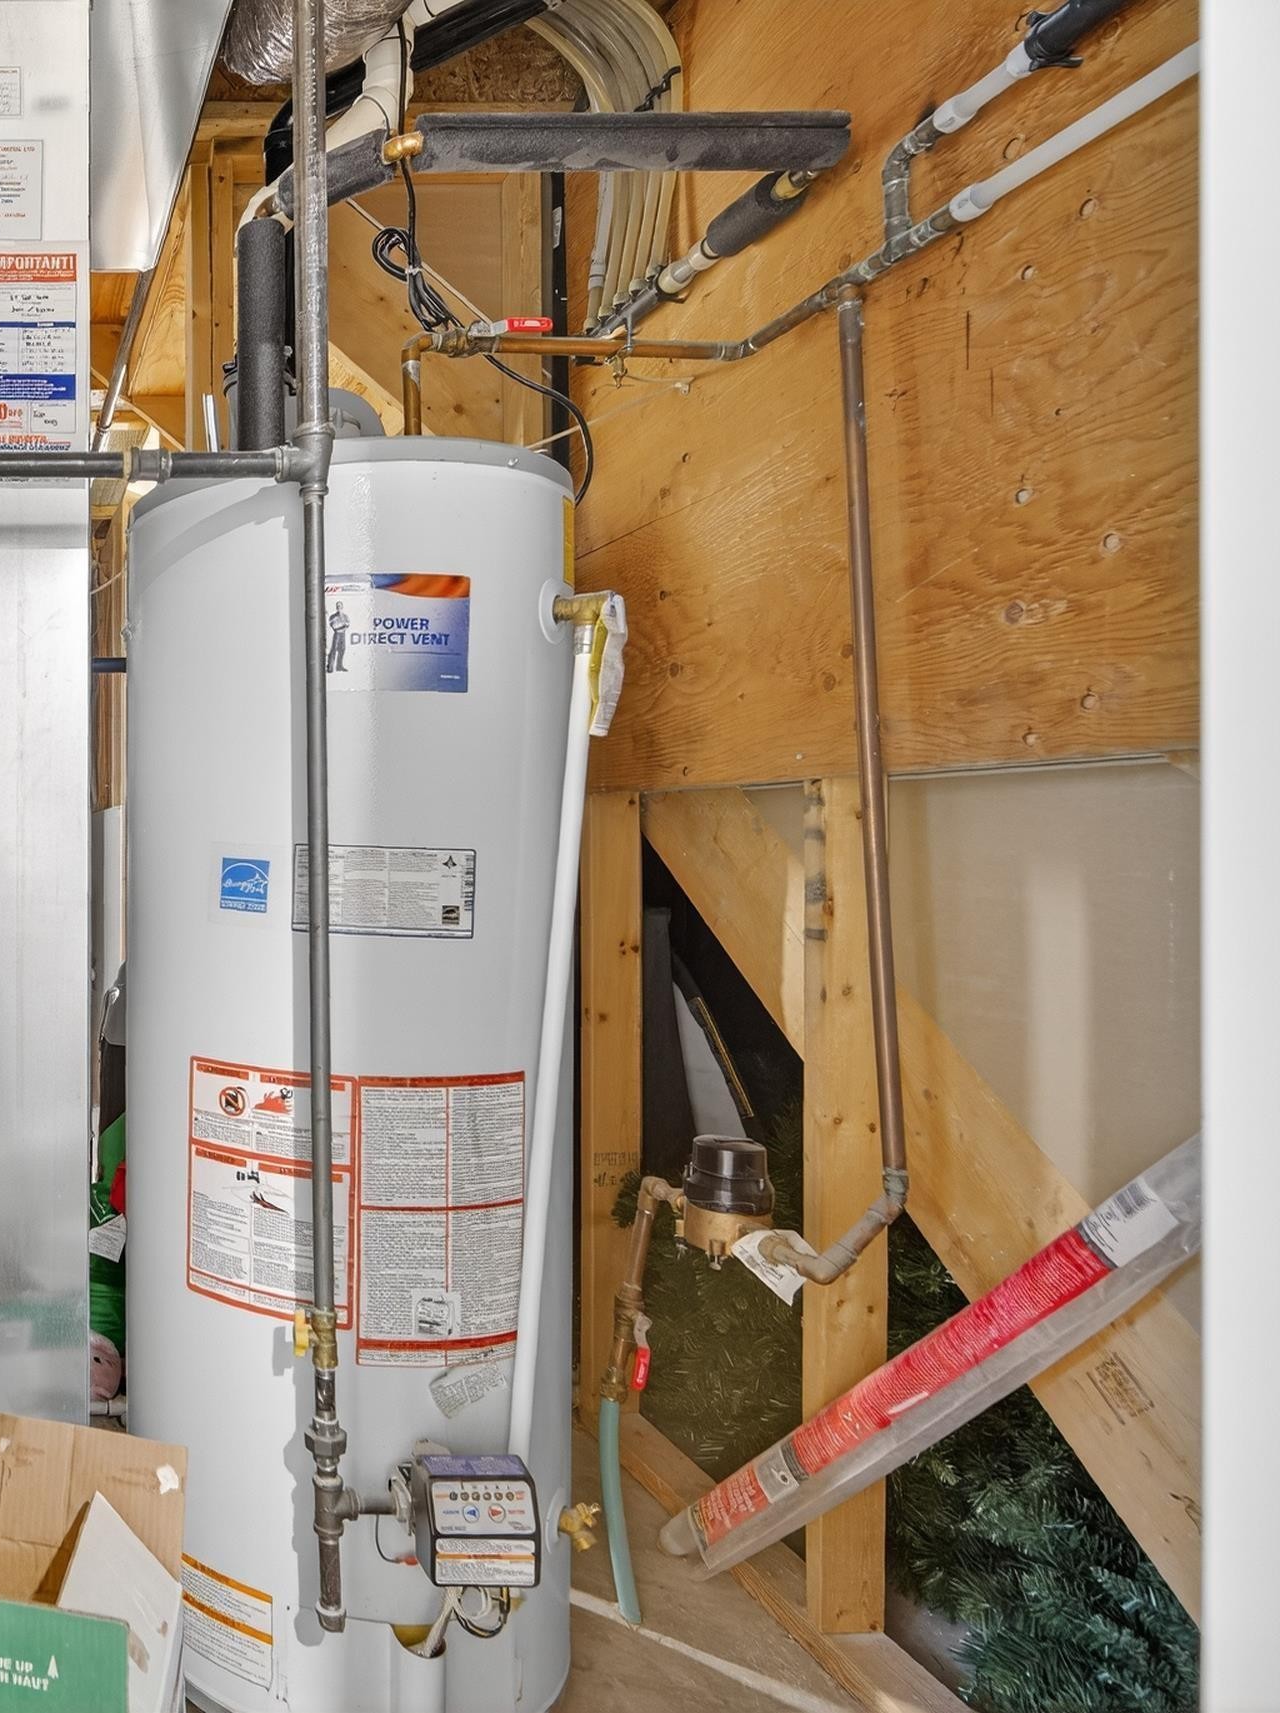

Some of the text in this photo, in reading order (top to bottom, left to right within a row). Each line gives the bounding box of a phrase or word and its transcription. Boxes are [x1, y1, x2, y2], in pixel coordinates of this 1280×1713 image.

[373, 618, 430, 631] POWER
[350, 632, 450, 646] DIRECT VENT
[15, 1660, 34, 1674] UP
